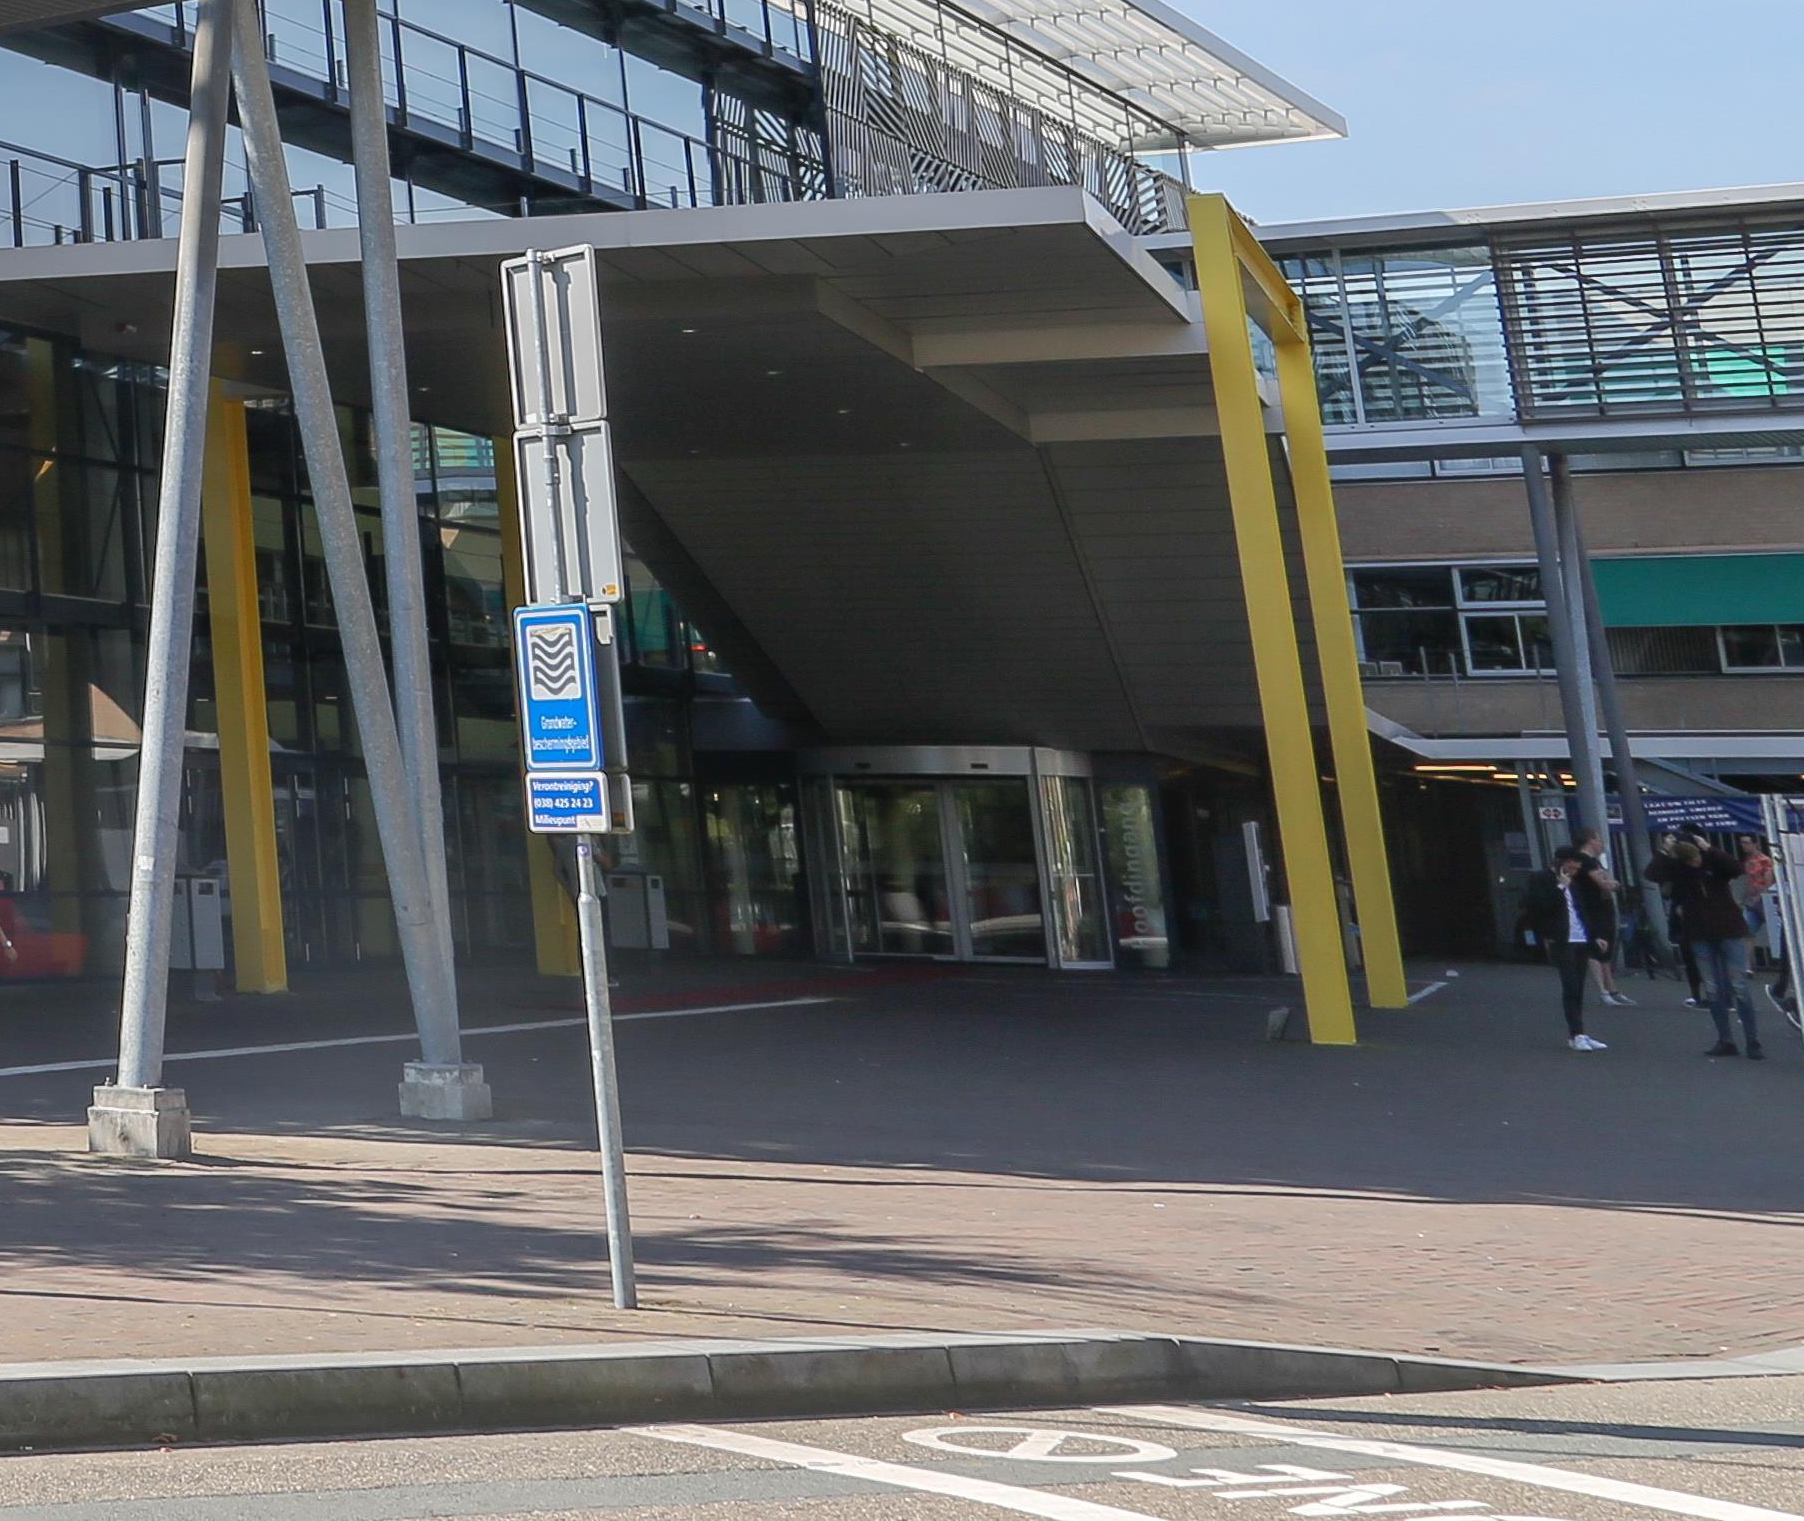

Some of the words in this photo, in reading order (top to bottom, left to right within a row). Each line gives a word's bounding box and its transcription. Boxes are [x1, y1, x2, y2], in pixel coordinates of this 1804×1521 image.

[554, 798, 570, 808] 425
[571, 798, 581, 808] 24
[582, 798, 594, 808] 23
